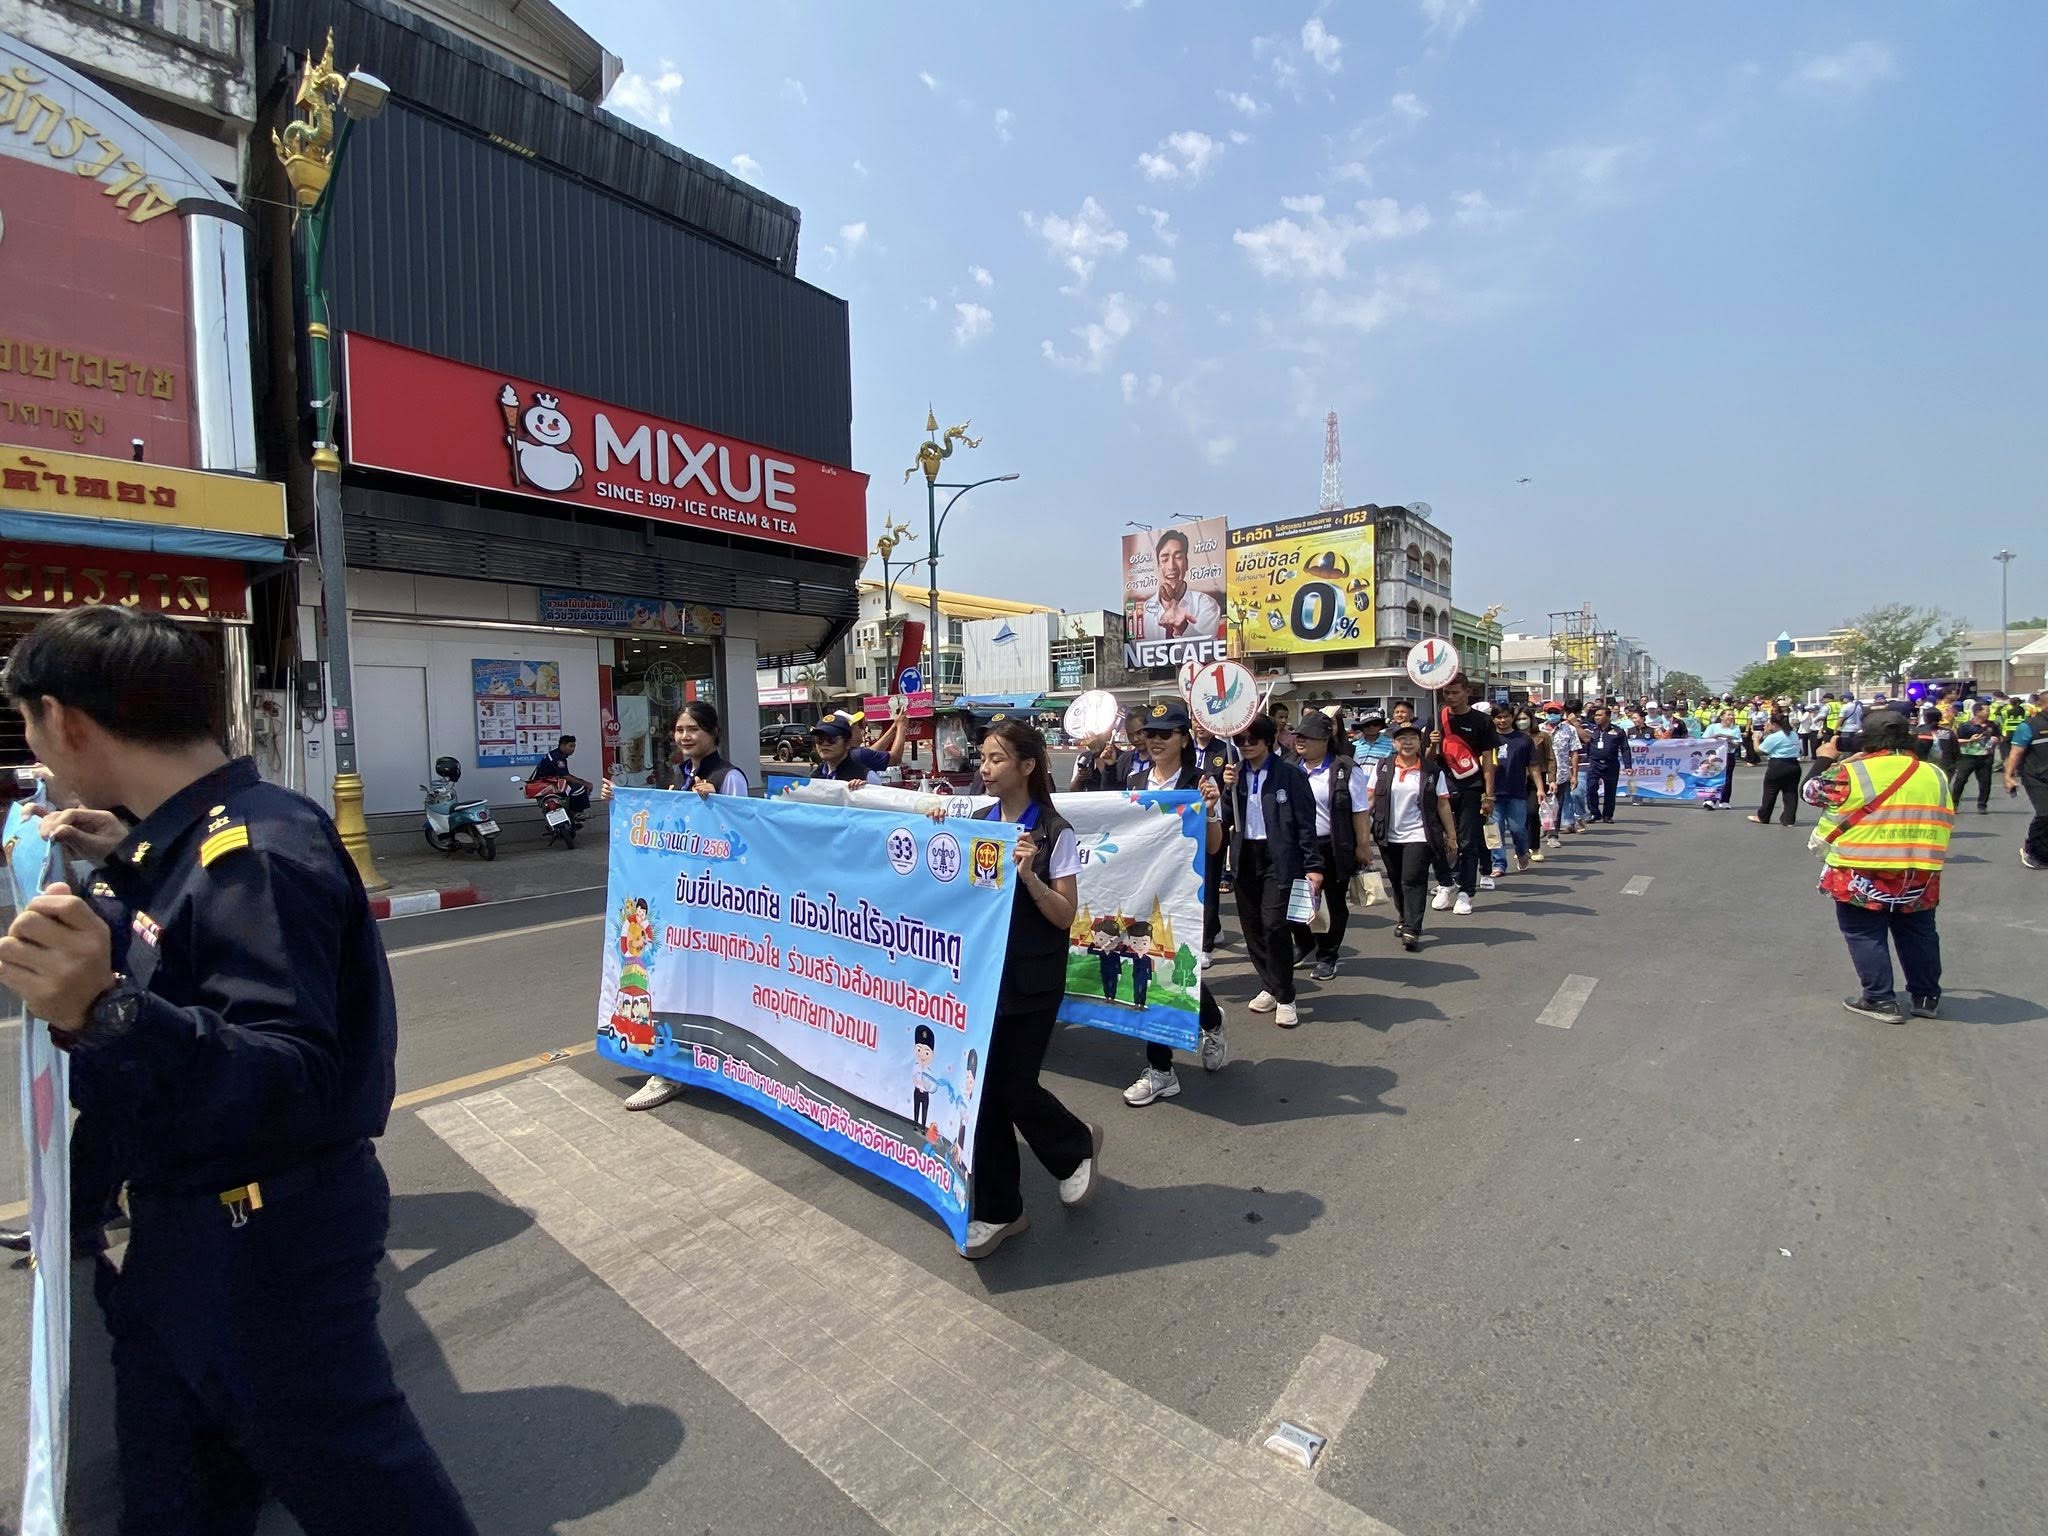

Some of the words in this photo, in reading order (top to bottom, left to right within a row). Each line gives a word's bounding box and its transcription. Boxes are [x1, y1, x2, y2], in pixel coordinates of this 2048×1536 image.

[595, 413, 797, 514] MIXUE
[596, 482, 644, 504] SINCE
[648, 492, 675, 510] 1997
[685, 499, 707, 517] ICE
[711, 505, 757, 527] CREAM
[760, 516, 770, 529] &
[773, 518, 797, 535] TEA
[1343, 511, 1367, 525] 1153
[1235, 546, 1302, 573] ผ่อนชิลล์
[630, 810, 690, 851] สงกรานต์
[690, 835, 701, 854] ปี
[702, 839, 731, 858] 2568
[892, 835, 913, 860] 33
[675, 869, 781, 921] ขับขี่ปลอดภัย
[789, 891, 962, 979] เมืองไทยไร้อุบัติเหตุ
[665, 925, 780, 969] คุมประพฤติห่วงใย
[787, 945, 967, 1031] ร่วมสร้างสังคมปลอดภัย
[751, 983, 879, 1050] ลดอุบัติภัยทางถนน
[693, 1045, 718, 1073] โดย
[722, 1054, 951, 1192] สำนักงานคุมประพฤติจังหวัดหนองคาย
